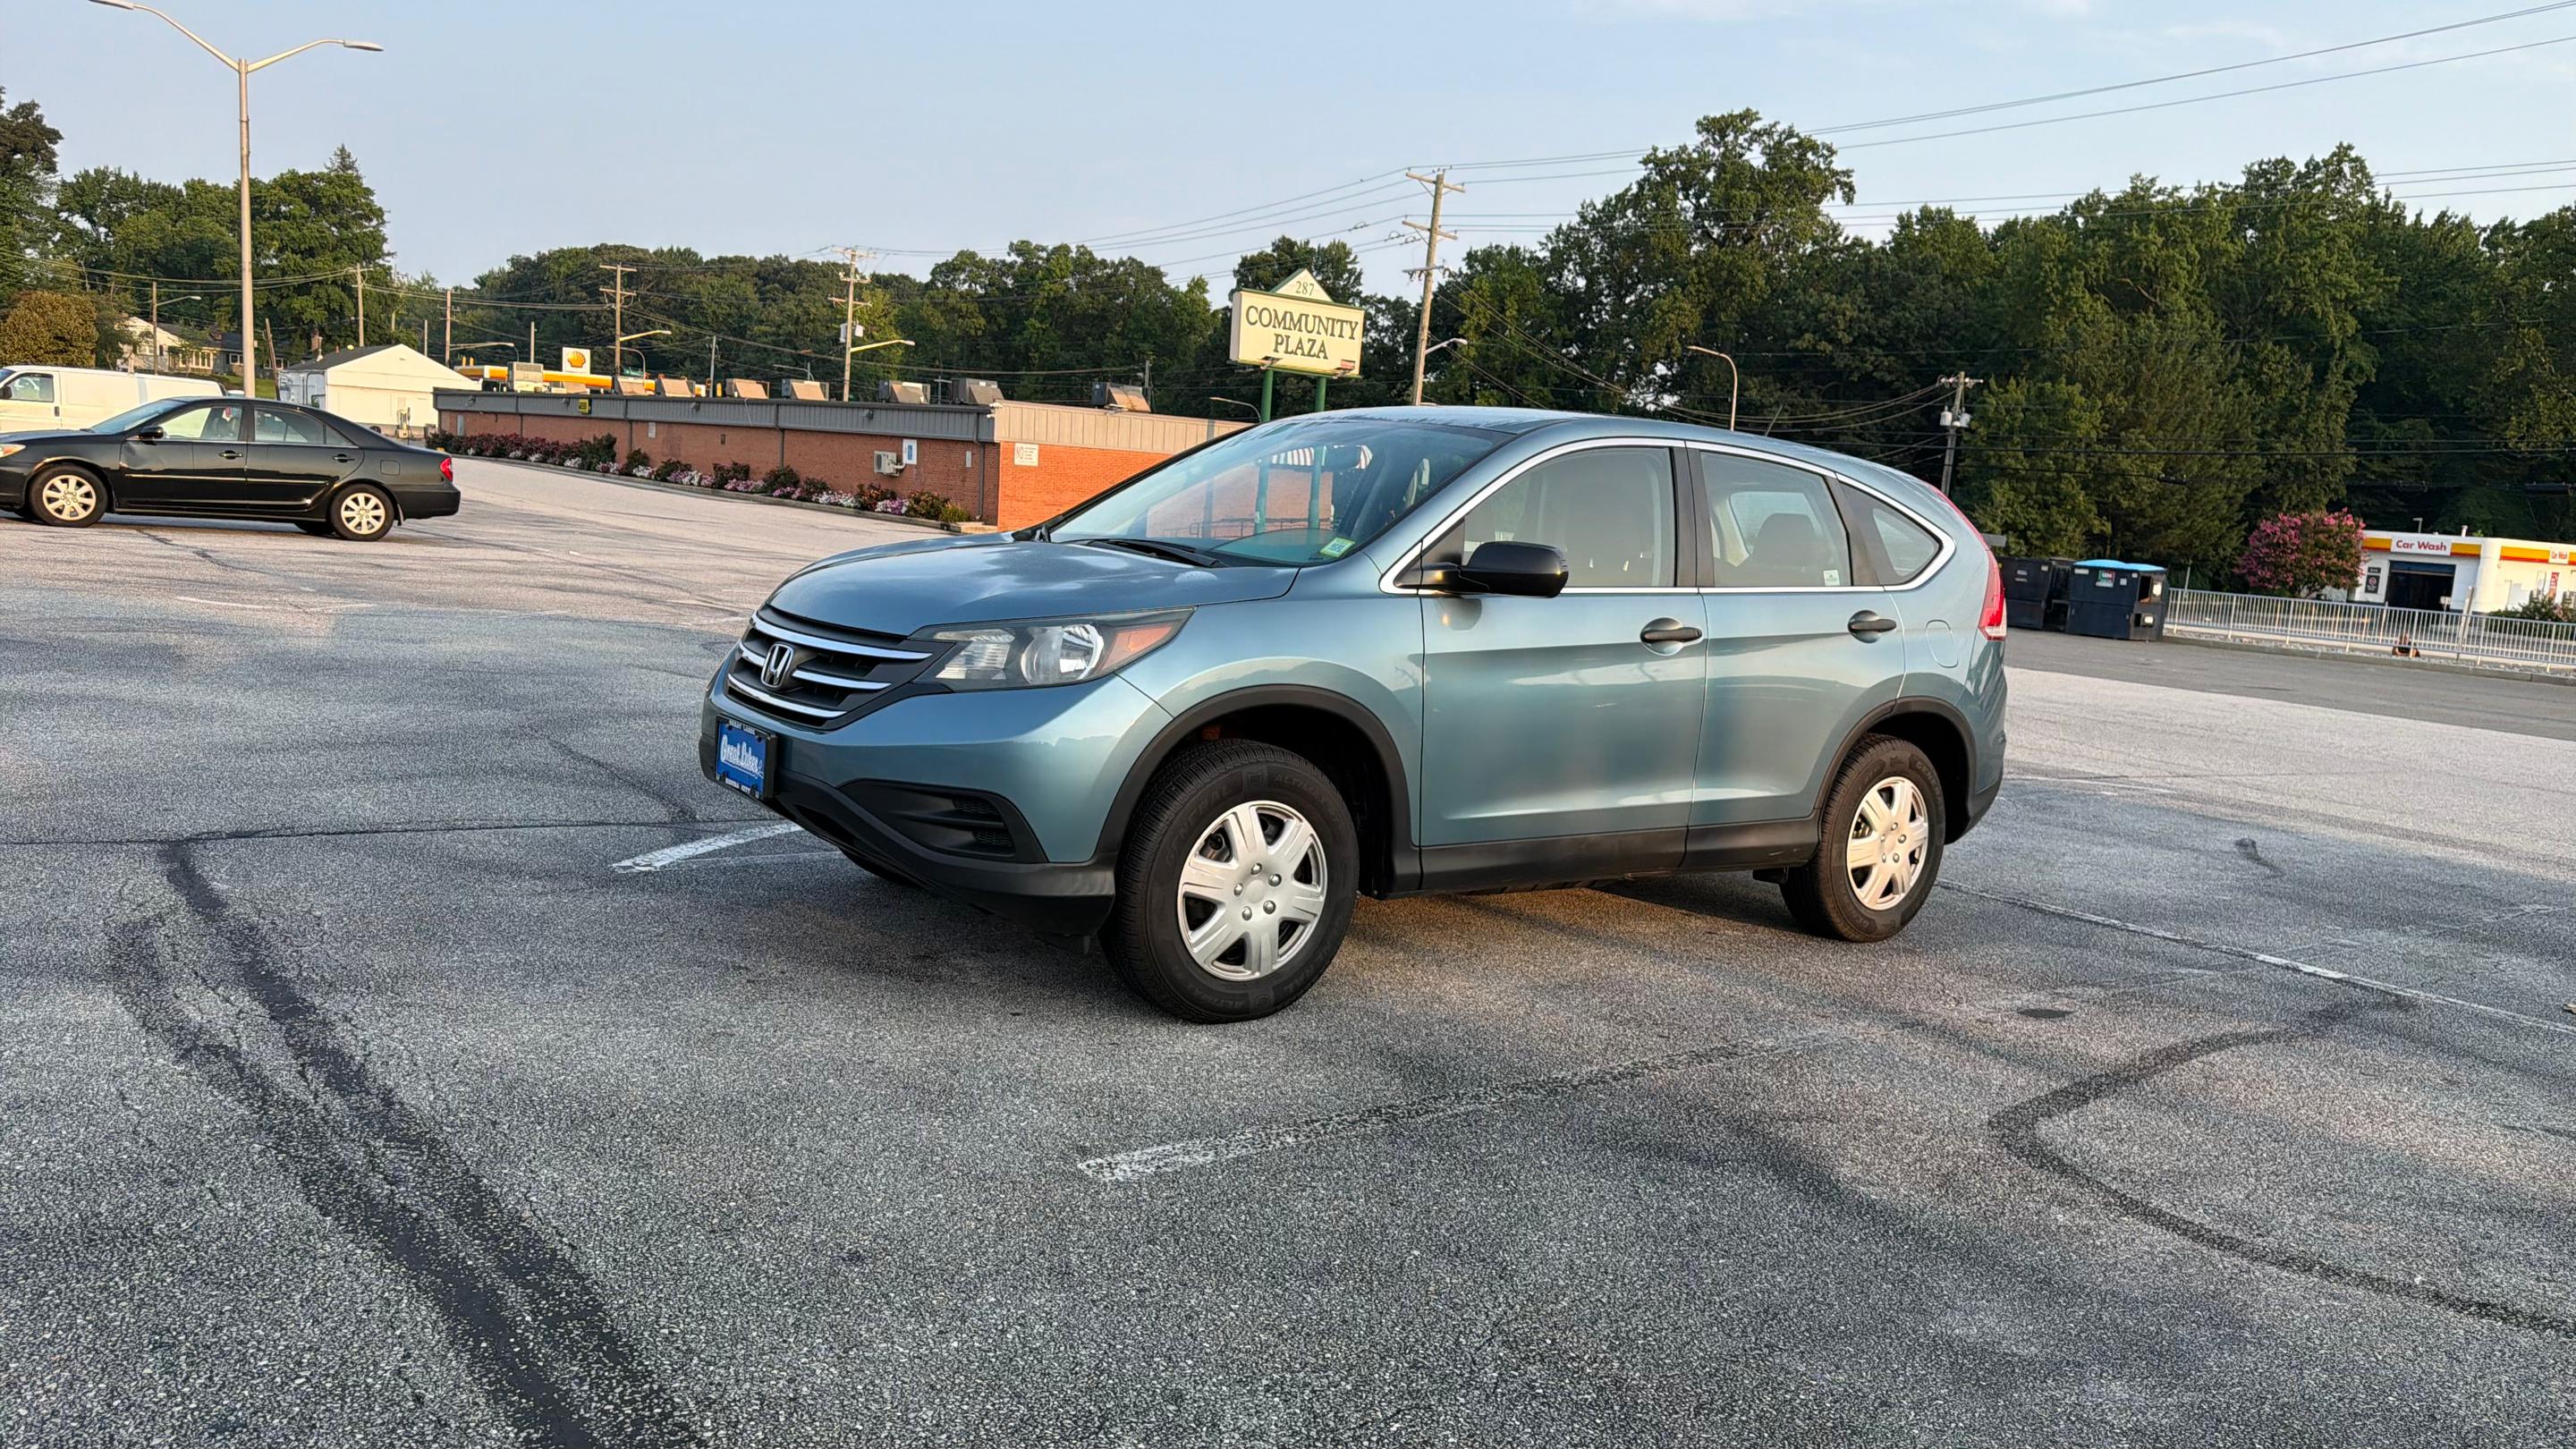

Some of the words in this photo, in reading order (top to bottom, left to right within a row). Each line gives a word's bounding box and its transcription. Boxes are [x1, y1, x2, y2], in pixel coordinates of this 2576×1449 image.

[1295, 281, 1315, 296] 287
[1245, 305, 1359, 340] COMMUNITY
[1273, 333, 1328, 360] PLAZA
[2396, 539, 2415, 549] Car
[2418, 541, 2447, 552] Wash
